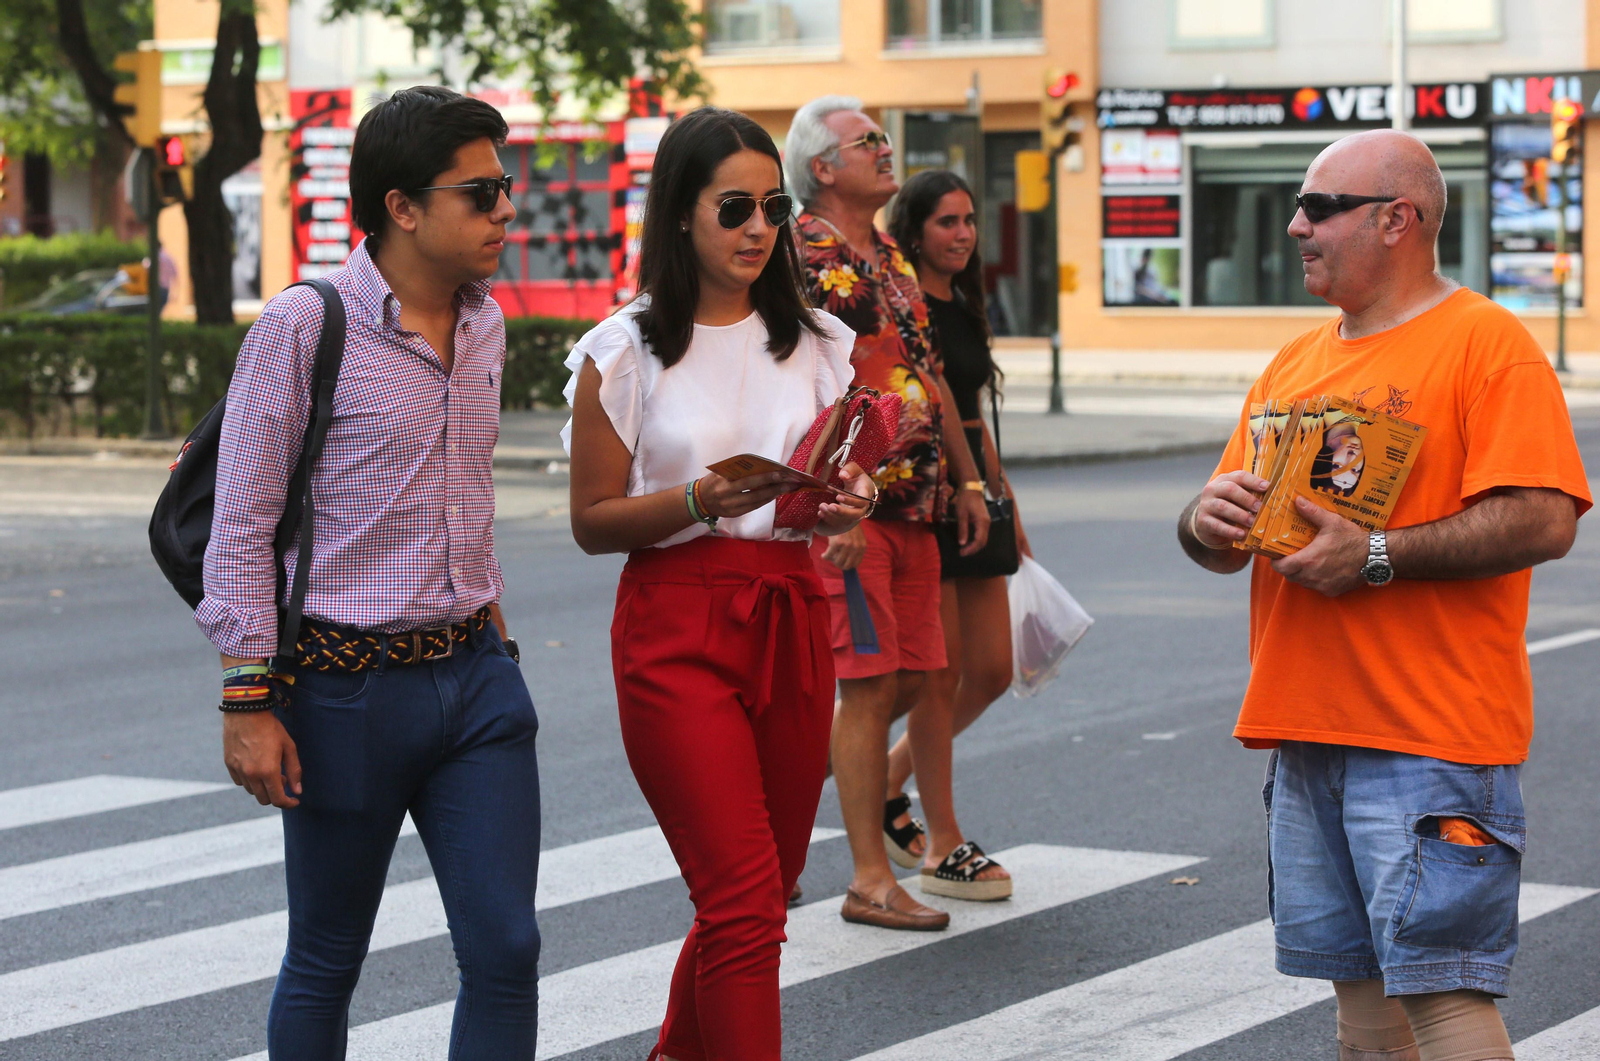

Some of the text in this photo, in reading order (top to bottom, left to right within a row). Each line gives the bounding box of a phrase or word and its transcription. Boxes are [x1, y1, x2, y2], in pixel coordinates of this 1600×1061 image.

[1333, 498, 1350, 508] sueño
[1359, 507, 1372, 515] vida
[1372, 510, 1379, 518] La
[1379, 513, 1387, 521] 18
[1290, 524, 1306, 534] 2018
